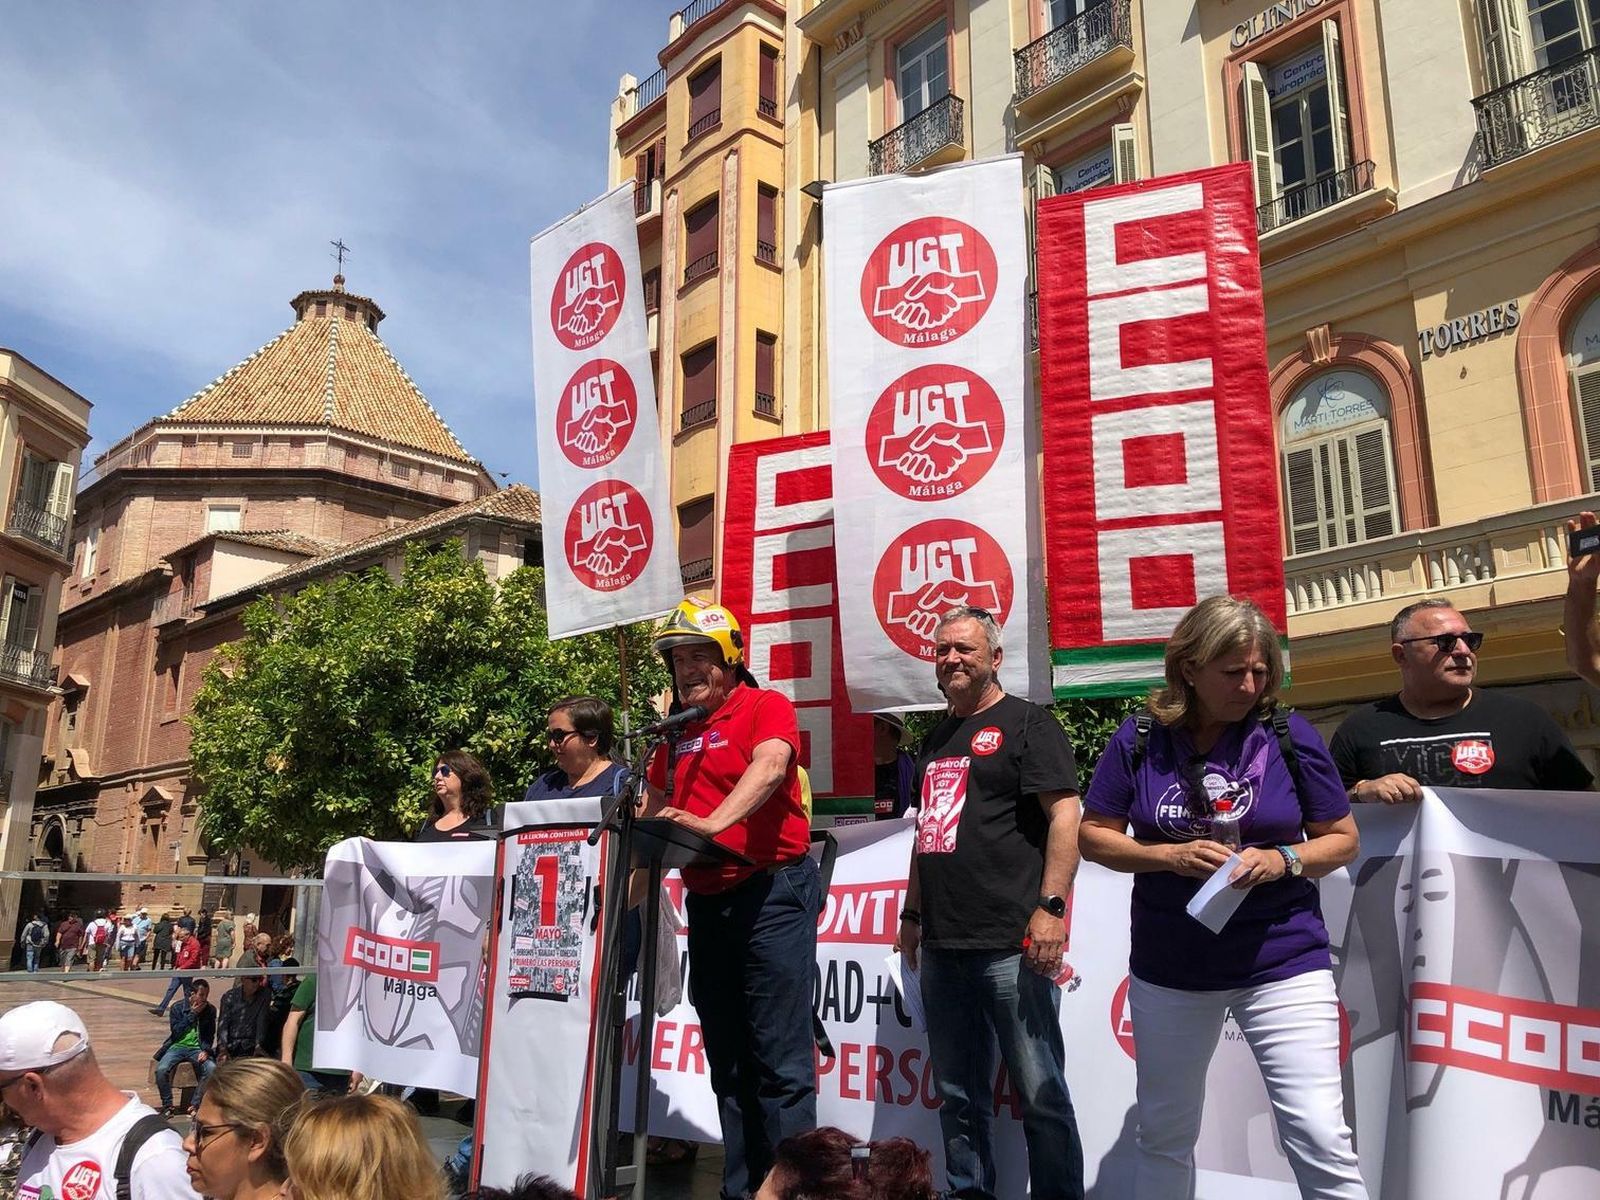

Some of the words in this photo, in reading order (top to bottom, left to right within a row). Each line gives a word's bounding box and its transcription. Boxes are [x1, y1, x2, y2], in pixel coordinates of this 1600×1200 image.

[1283, 54, 1324, 80] Centro
[1078, 158, 1110, 180] Centro
[889, 233, 965, 286] UGT
[565, 253, 606, 299] UGT
[574, 329, 605, 349] Málaga
[903, 328, 958, 344] Málaga
[1418, 299, 1521, 355] TORRES
[571, 370, 616, 416] UGT
[893, 381, 971, 437] UGT
[1083, 183, 1230, 642] CCOO
[582, 449, 617, 466] Málaga
[908, 478, 964, 497] Málaga
[581, 492, 630, 541] UGT
[901, 537, 979, 593] UGT
[596, 572, 632, 589] Málaga
[976, 730, 1000, 743] UGT
[1456, 746, 1488, 758] UGT
[534, 855, 559, 927] 1
[535, 928, 561, 940] MAYO
[352, 935, 409, 972] CCOO
[384, 977, 437, 1000] Málaga
[1411, 998, 1600, 1078] CCOO
[69, 1164, 100, 1191] UGT
